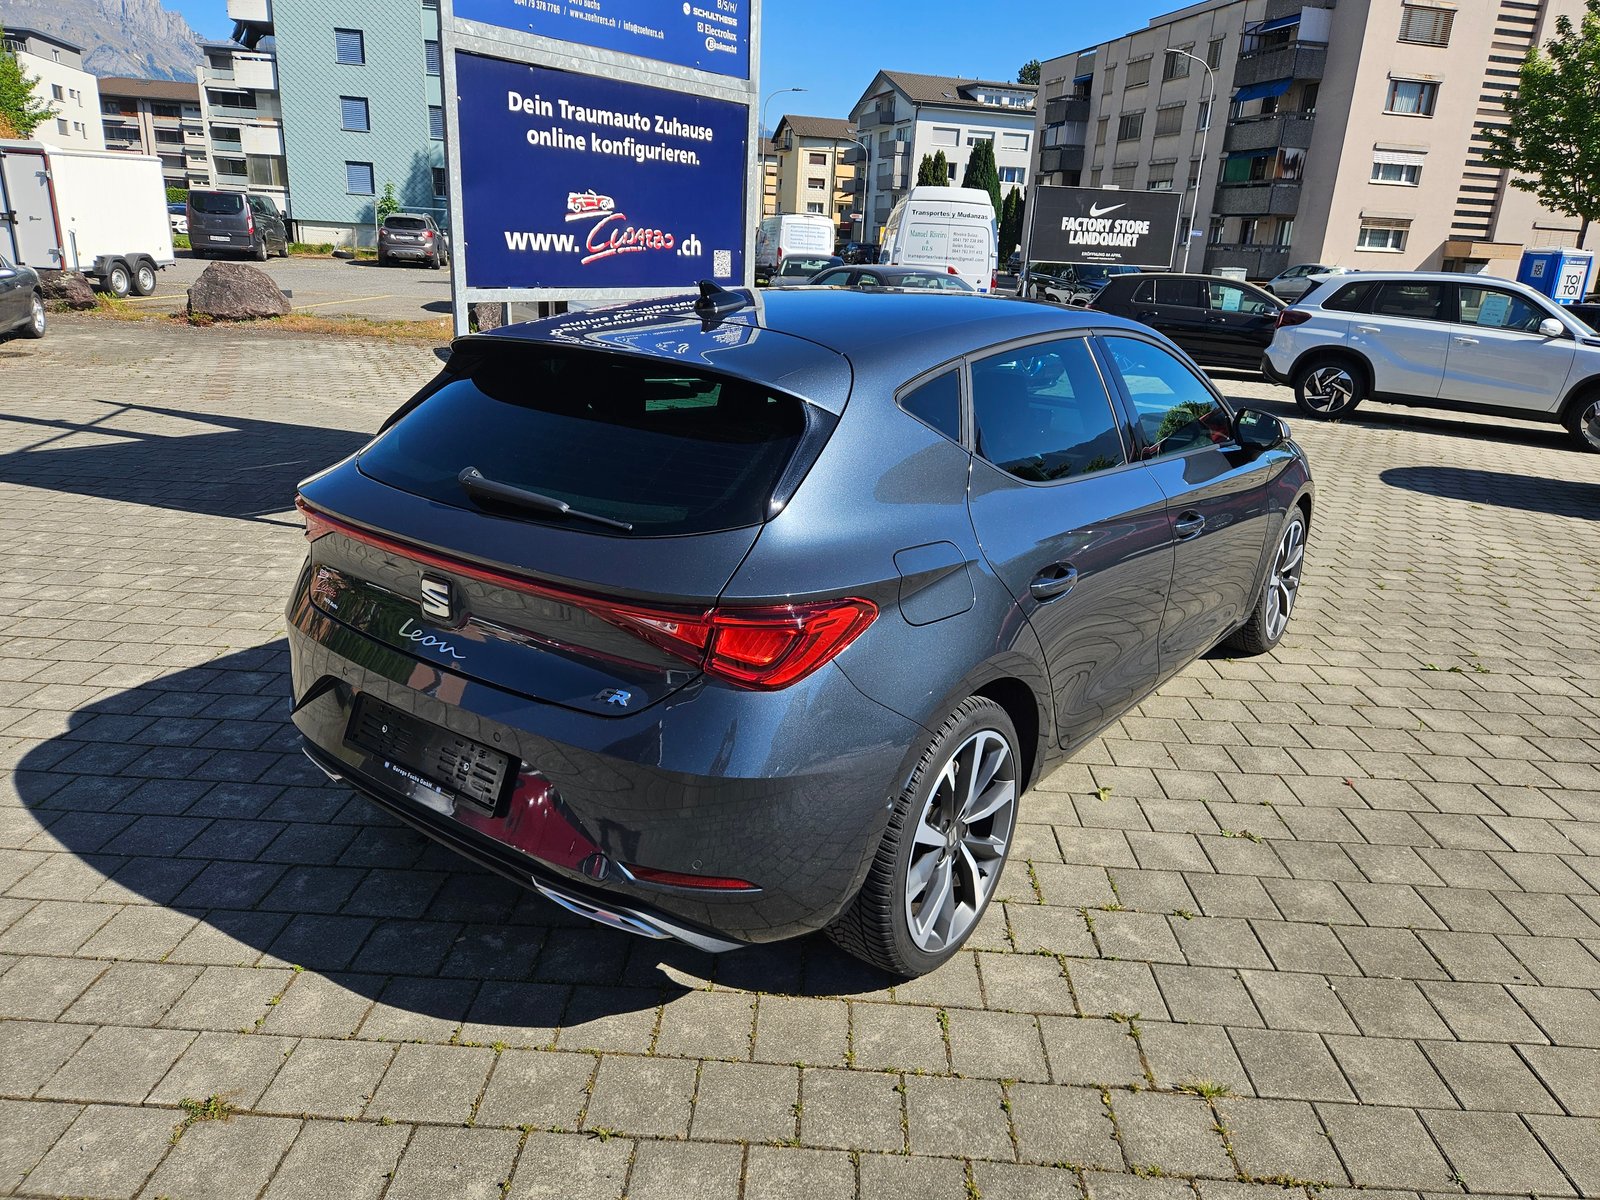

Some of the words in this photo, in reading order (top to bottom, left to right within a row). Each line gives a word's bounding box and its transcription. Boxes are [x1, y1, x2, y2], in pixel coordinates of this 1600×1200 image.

[583, 0, 600, 10] Buchs
[569, 9, 616, 27] www.zoehrers.ch
[623, 20, 665, 39] info@zoehrers.ch
[692, 7, 738, 27] SCHULTHESS
[704, 23, 737, 41] Electrolux
[508, 90, 553, 117] Dein
[558, 99, 651, 131] Traumauto
[654, 115, 713, 141] Zuhause
[527, 126, 586, 151] online
[591, 132, 700, 165] konfigurieren.
[912, 209, 950, 217] Transportes
[957, 211, 988, 220] Mudanzas
[910, 229, 929, 238] Manuel
[1061, 216, 1113, 232] FACTORY
[1113, 219, 1150, 235] STORE
[1068, 231, 1139, 247] LANDQUART
[1566, 275, 1582, 285] TOI
[1563, 285, 1579, 295] TOI
[398, 617, 467, 659] Leon
[392, 764, 407, 777] Garage
[419, 778, 433, 789] GmbH
